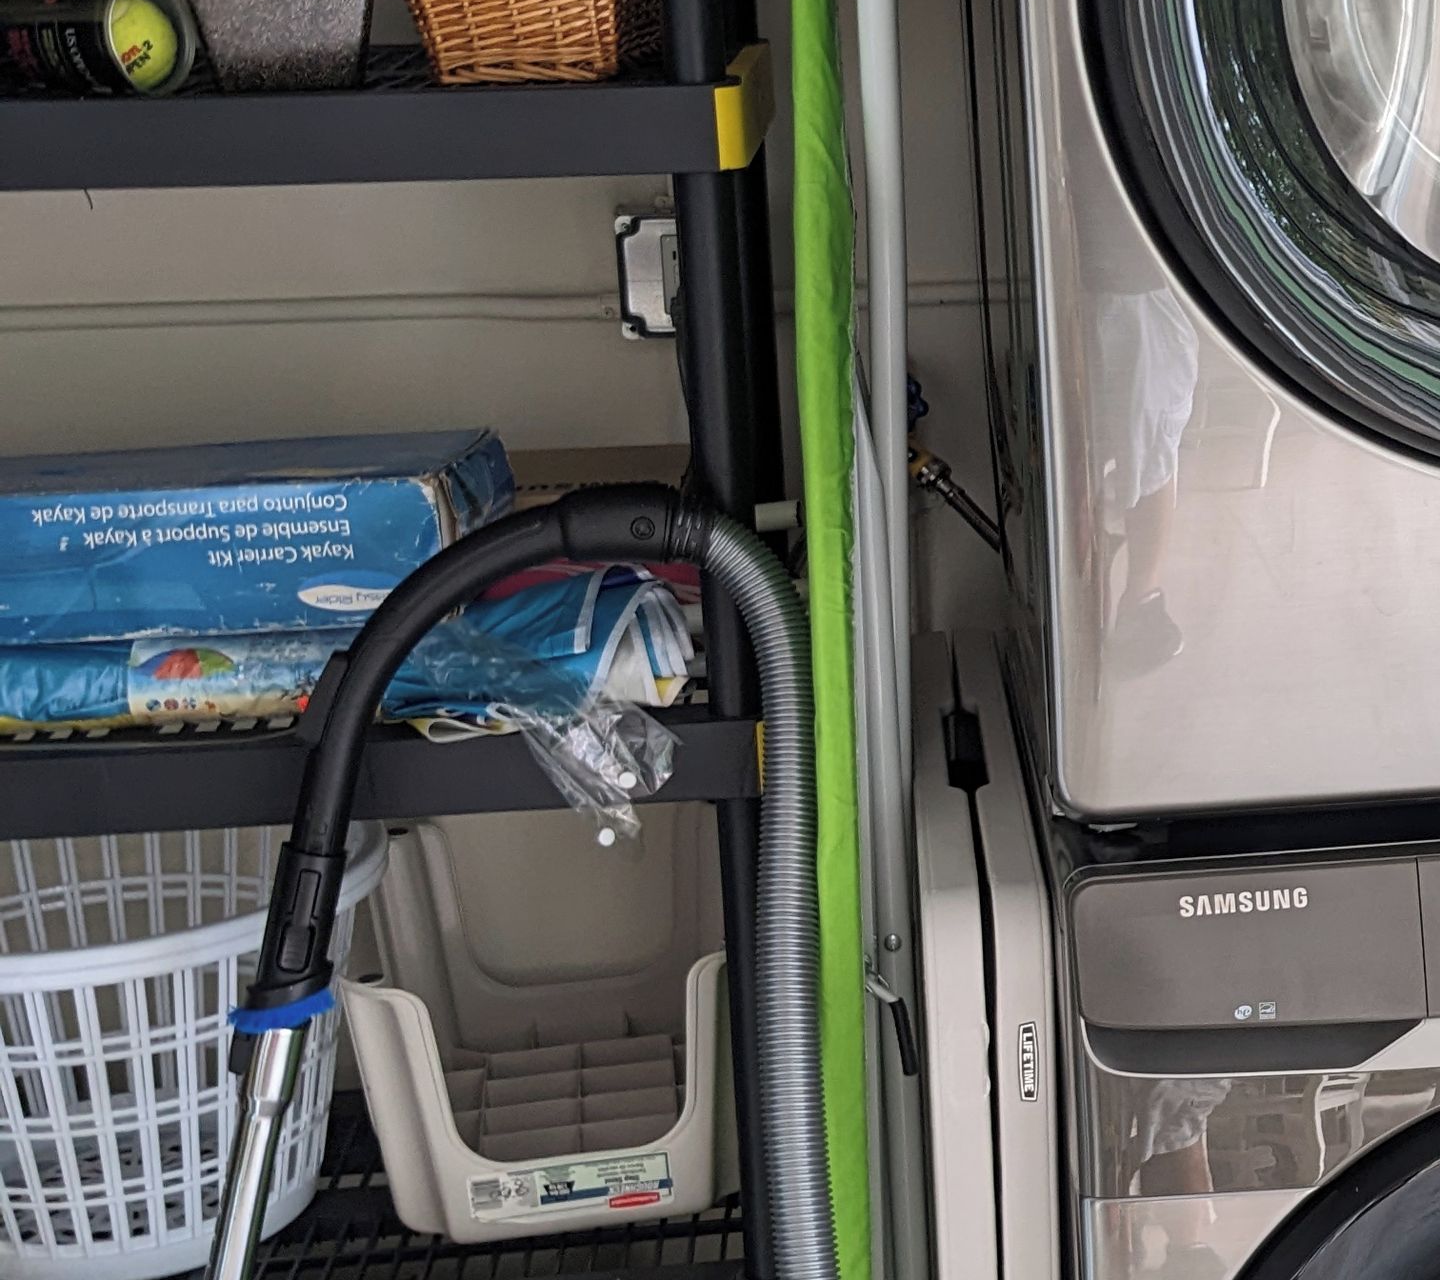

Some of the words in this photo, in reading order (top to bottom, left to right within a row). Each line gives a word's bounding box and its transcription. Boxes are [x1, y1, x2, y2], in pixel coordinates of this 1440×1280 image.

[118, 500, 217, 519] Transporte
[219, 496, 258, 514] para
[263, 494, 348, 514] Conjunto
[32, 504, 86, 527] Kayak
[91, 506, 113, 523] de
[83, 527, 138, 550] Kayak
[141, 529, 152, 547] à
[156, 523, 231, 543] Support
[235, 523, 258, 541] de
[263, 520, 350, 540] Ensemble
[208, 549, 233, 567] Kit
[237, 546, 297, 565] Carrier
[302, 541, 355, 562] Kayak
[1179, 887, 1308, 917] SAMSUNG
[1023, 1032, 1035, 1092] LIFETIME
